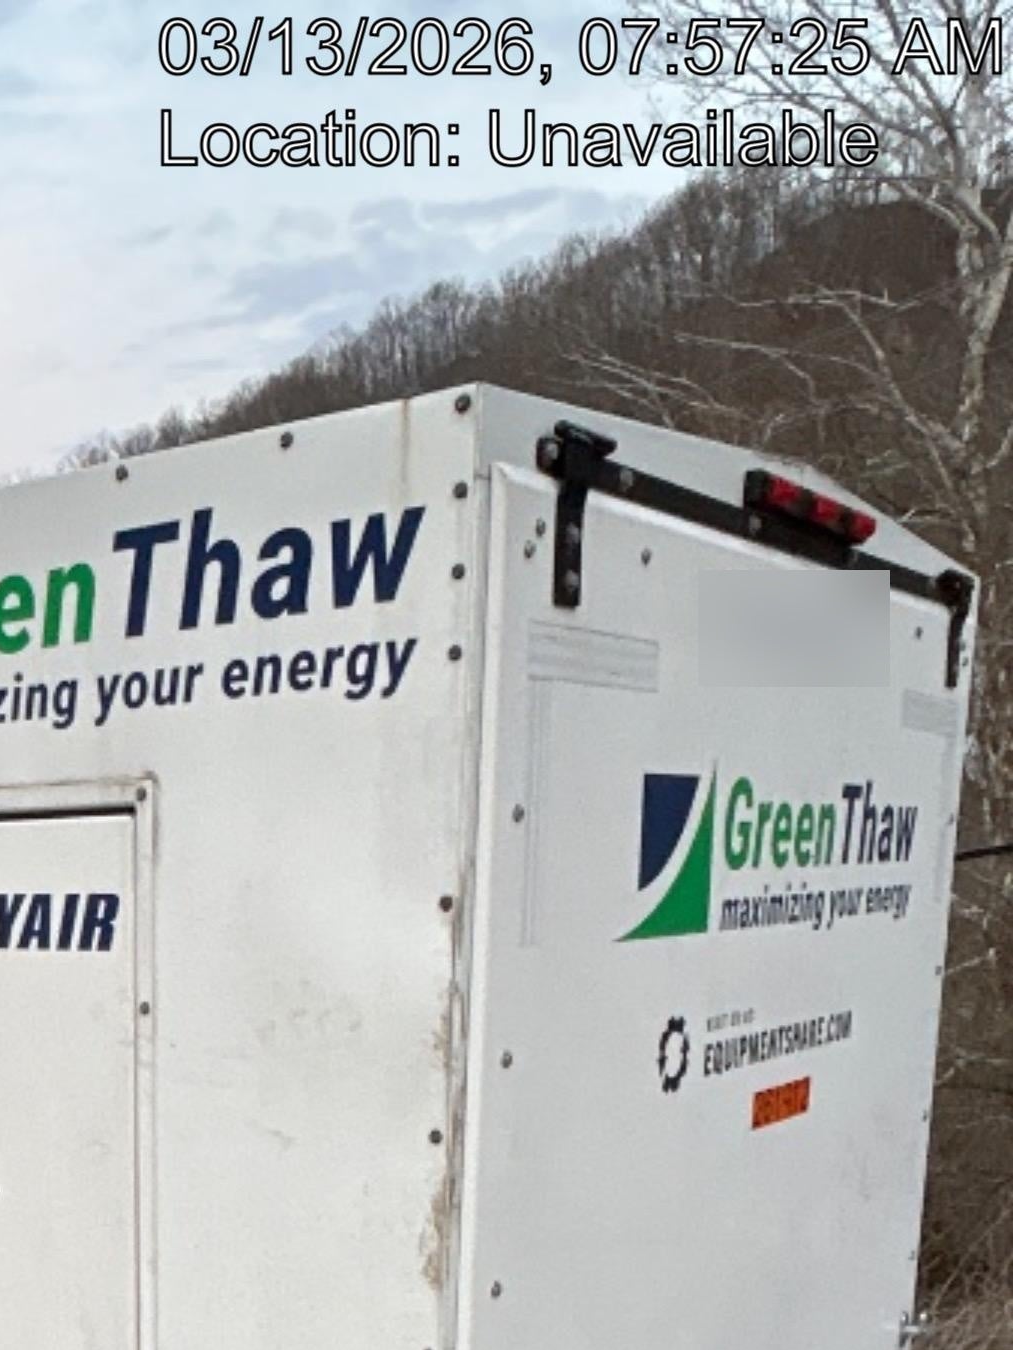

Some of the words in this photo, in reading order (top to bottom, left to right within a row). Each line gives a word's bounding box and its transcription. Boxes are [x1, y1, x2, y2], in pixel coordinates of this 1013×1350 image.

[94, 661, 205, 725] your
[221, 637, 418, 700] energy
[719, 883, 825, 932] maximizing
[828, 887, 864, 930] your
[866, 883, 912, 919] energy
